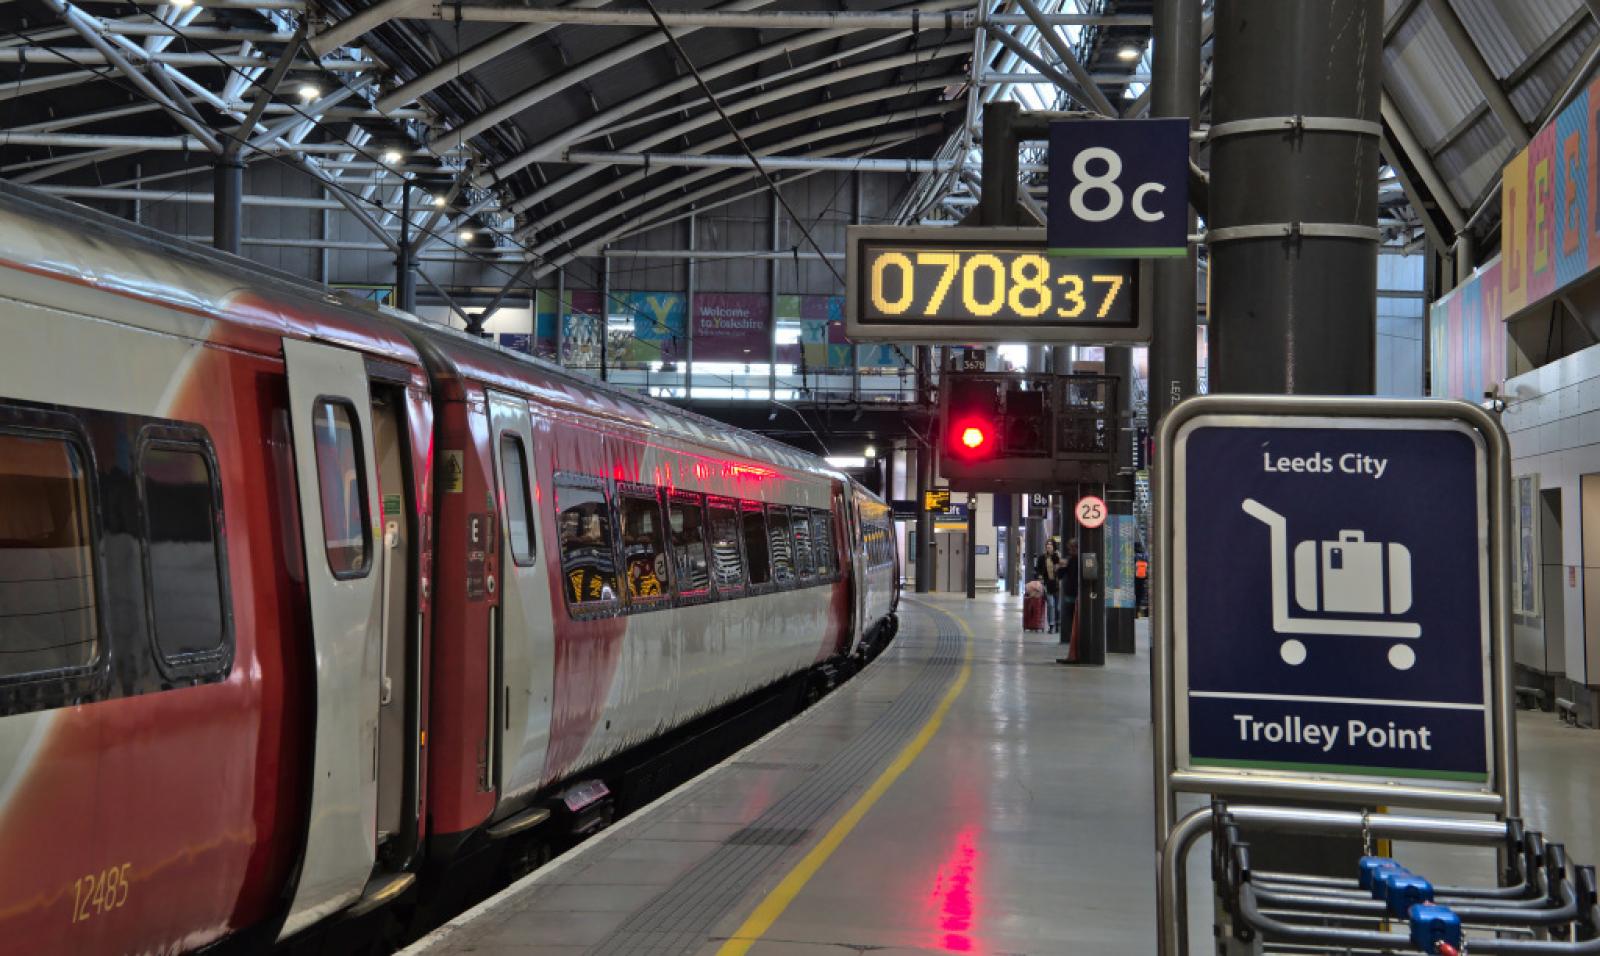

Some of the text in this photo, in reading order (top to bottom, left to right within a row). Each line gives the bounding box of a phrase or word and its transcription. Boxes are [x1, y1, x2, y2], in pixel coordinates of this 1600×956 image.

[700, 306, 752, 318] Welcome
[701, 317, 764, 329] to Yorkshire
[1263, 452, 1389, 480] Leeds City
[1082, 503, 1101, 520] 25
[471, 518, 479, 543] E
[1233, 714, 1432, 752] Trolley Point
[72, 861, 132, 924] 12485
